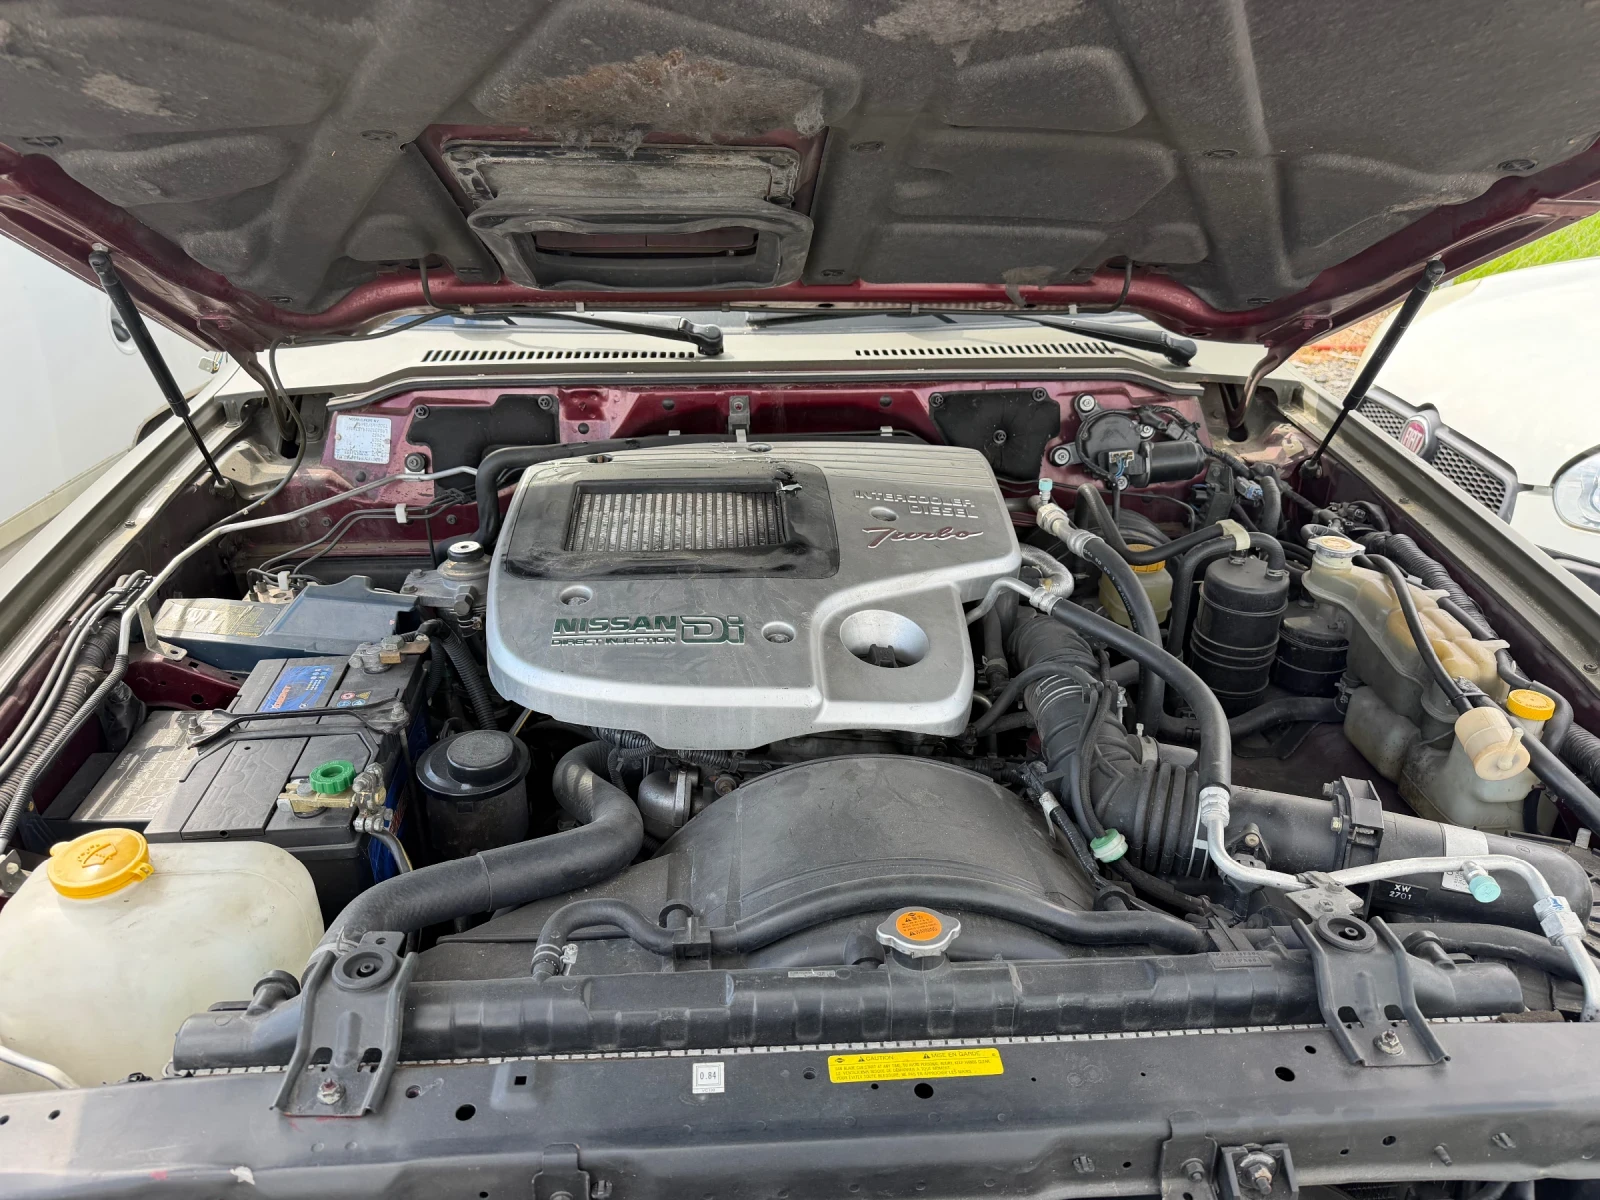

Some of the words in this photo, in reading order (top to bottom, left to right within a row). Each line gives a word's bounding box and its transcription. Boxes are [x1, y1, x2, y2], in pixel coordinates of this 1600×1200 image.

[1402, 427, 1424, 453] FIAT
[853, 490, 976, 508] INTERCOOLER
[908, 504, 979, 519] DIESEL
[861, 526, 984, 549] Turbo
[553, 615, 677, 635] NISSAN
[551, 636, 602, 647] DIRECT
[604, 636, 677, 646] INJECTION
[1388, 891, 1412, 900] 2701
[1394, 884, 1412, 893] XW
[699, 1071, 717, 1080] 0.84
